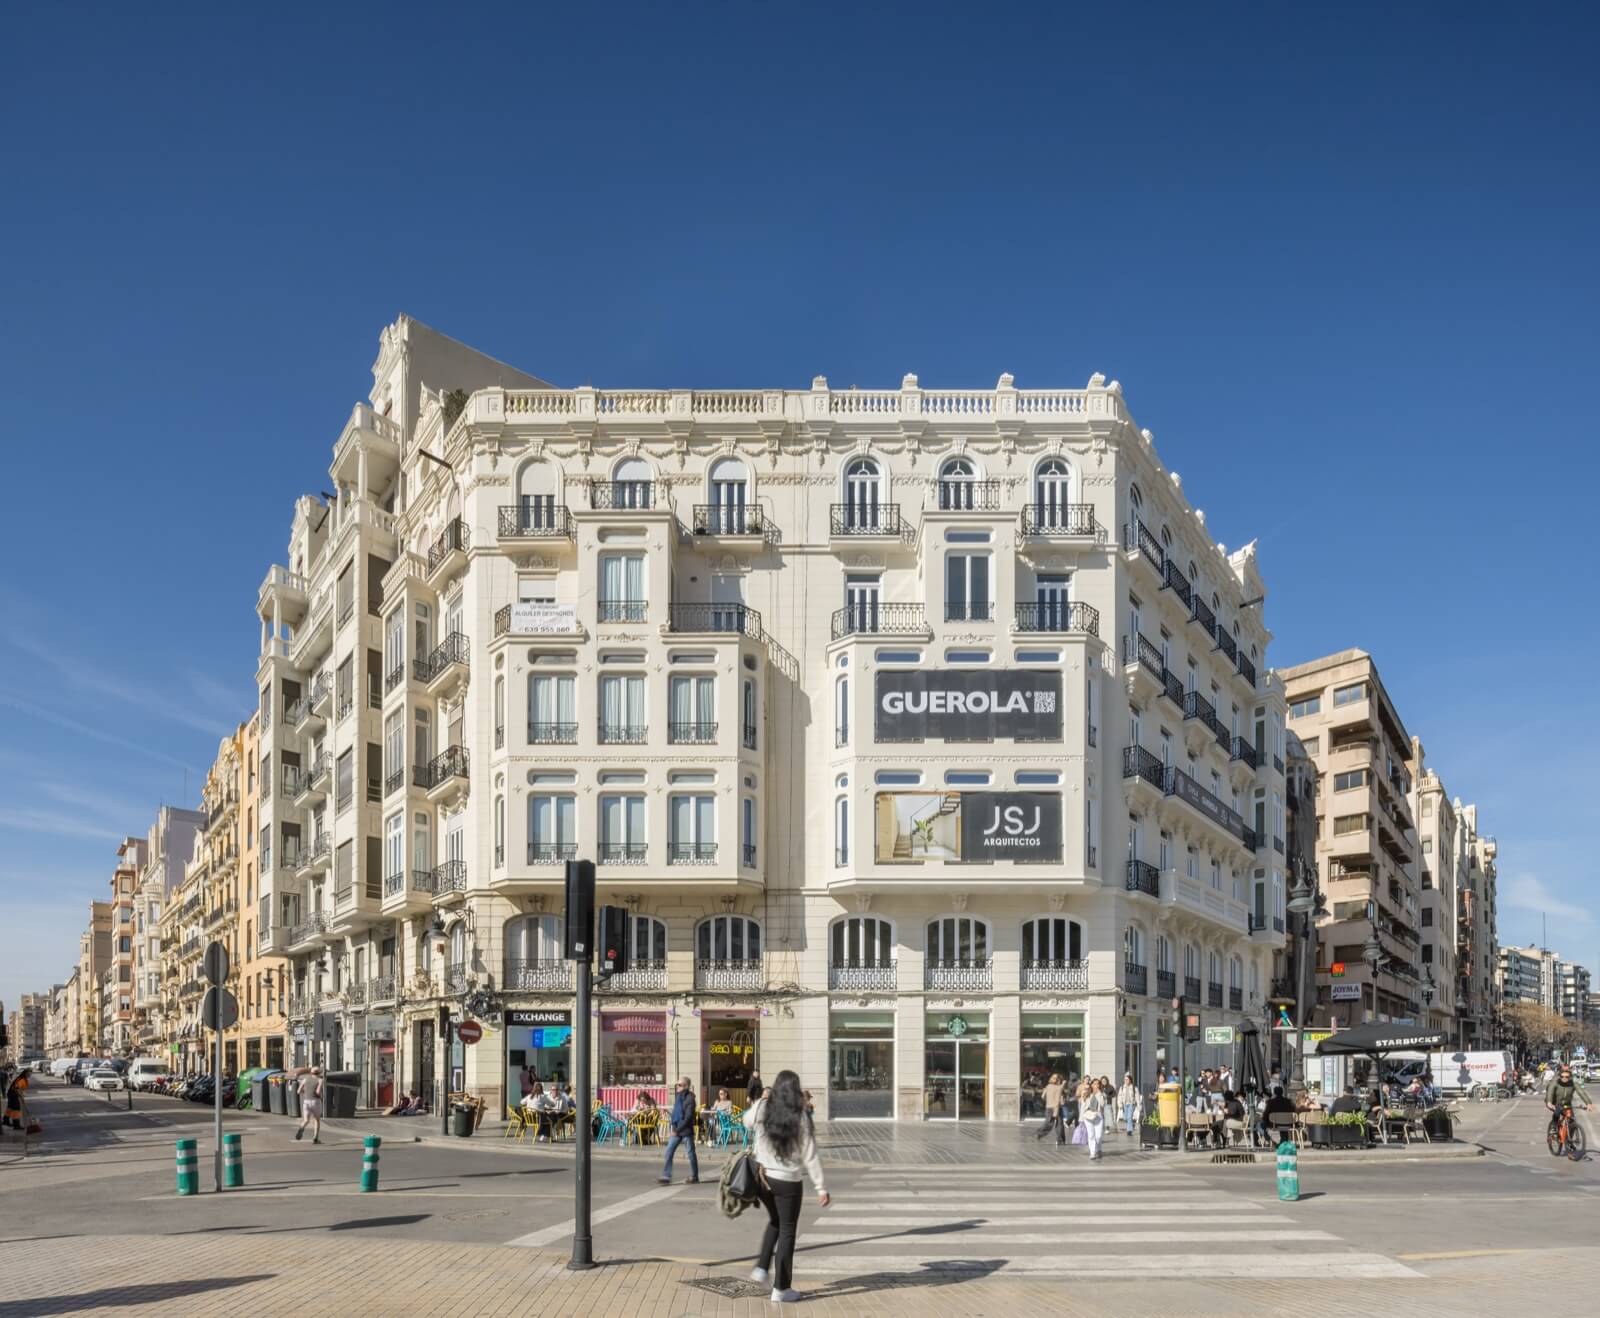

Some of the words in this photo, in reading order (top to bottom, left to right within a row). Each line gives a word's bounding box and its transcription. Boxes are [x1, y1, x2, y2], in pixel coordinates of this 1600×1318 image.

[983, 805, 1041, 835] JSJ
[983, 837, 1041, 848] ARQUITECTOS
[1332, 985, 1360, 993] JOYMA
[512, 1012, 566, 1022] EXCHANGE
[1375, 1035, 1440, 1048] STARBUCKS
